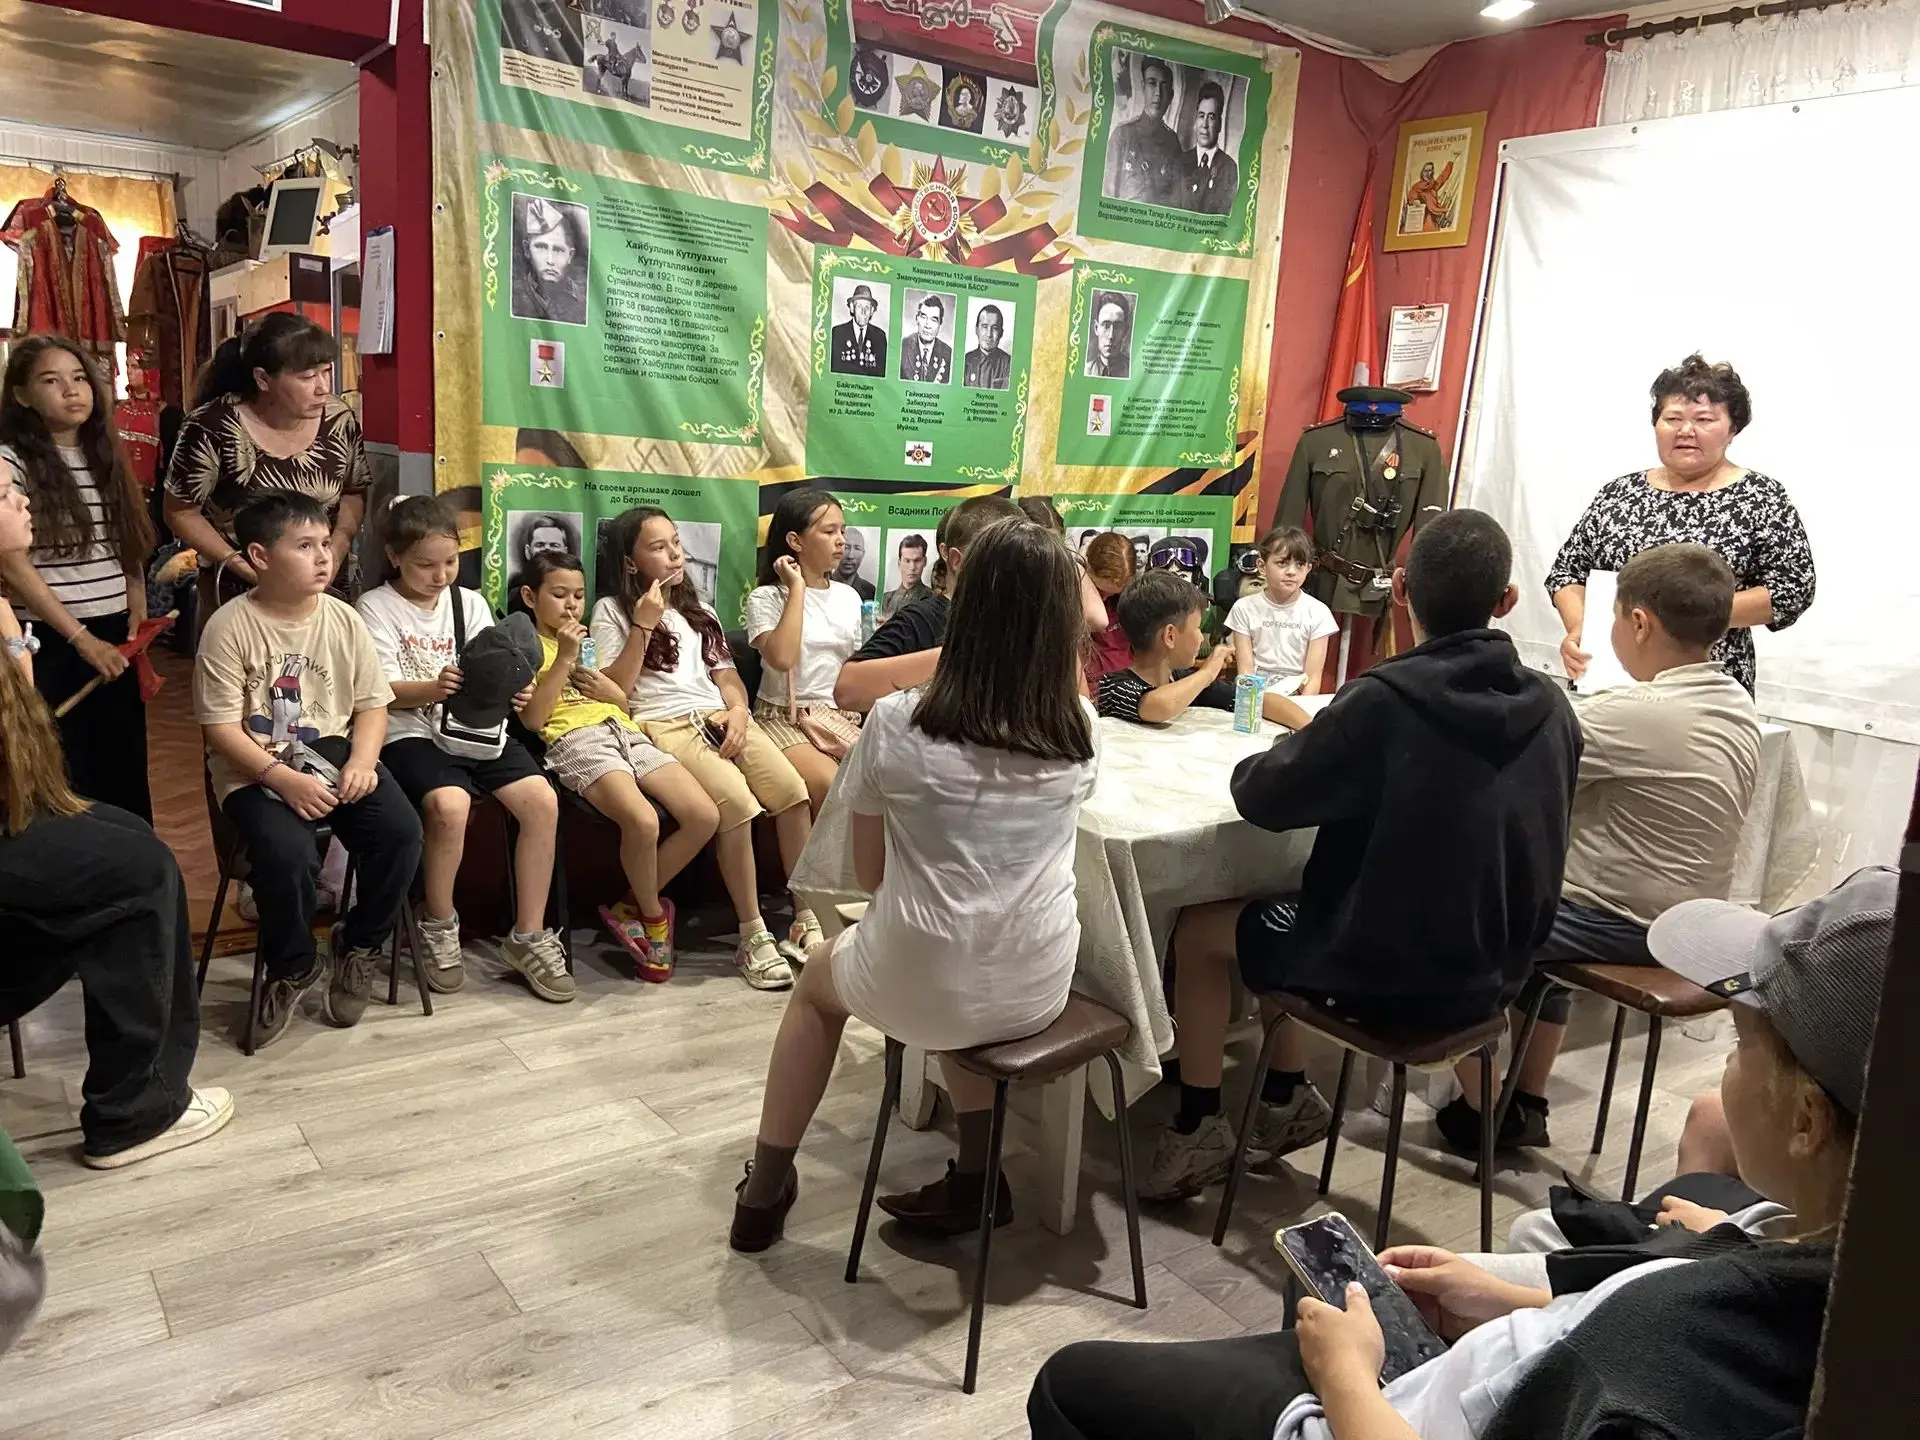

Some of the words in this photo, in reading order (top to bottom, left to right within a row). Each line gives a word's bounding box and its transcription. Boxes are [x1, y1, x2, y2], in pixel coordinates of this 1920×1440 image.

[625, 239, 674, 256] Хайбуллин
[676, 248, 728, 265] Кутлуахмет
[637, 255, 716, 276] Кутлугаллямович
[912, 265, 952, 279] Кавалеристы
[610, 263, 647, 278] Родился
[657, 271, 675, 283] 1921
[676, 276, 694, 287] году
[702, 280, 738, 292] деревне
[968, 282, 989, 292] БАССР
[606, 287, 640, 300] являлся
[641, 293, 692, 306] командиром
[693, 300, 735, 313] отделения
[666, 283, 673, 293] В
[694, 289, 720, 300] войны
[606, 297, 625, 307] ПТР
[626, 300, 636, 310] 58
[637, 303, 692, 318] гвардейского
[605, 319, 661, 335] Черниговской
[664, 329, 710, 341] кавдивизии
[643, 315, 667, 325] полка
[670, 318, 680, 327] 16
[681, 320, 729, 333] гвардейской
[604, 343, 637, 355] период
[638, 346, 667, 357] боевых
[668, 351, 706, 363] действий
[605, 332, 659, 346] гвардейского
[710, 344, 719, 354] За
[604, 355, 641, 365] сержант
[642, 357, 684, 371] Хайбуллин
[685, 365, 718, 375] показал
[720, 368, 737, 377] себя
[604, 366, 639, 377] смелым
[648, 371, 687, 382] отважным
[584, 481, 597, 491] На
[599, 483, 625, 493] своем
[627, 485, 670, 495] аргымаке
[671, 488, 701, 497] дошел
[609, 495, 621, 505] до
[623, 495, 660, 506] Берлина
[888, 505, 930, 517] Всадники
